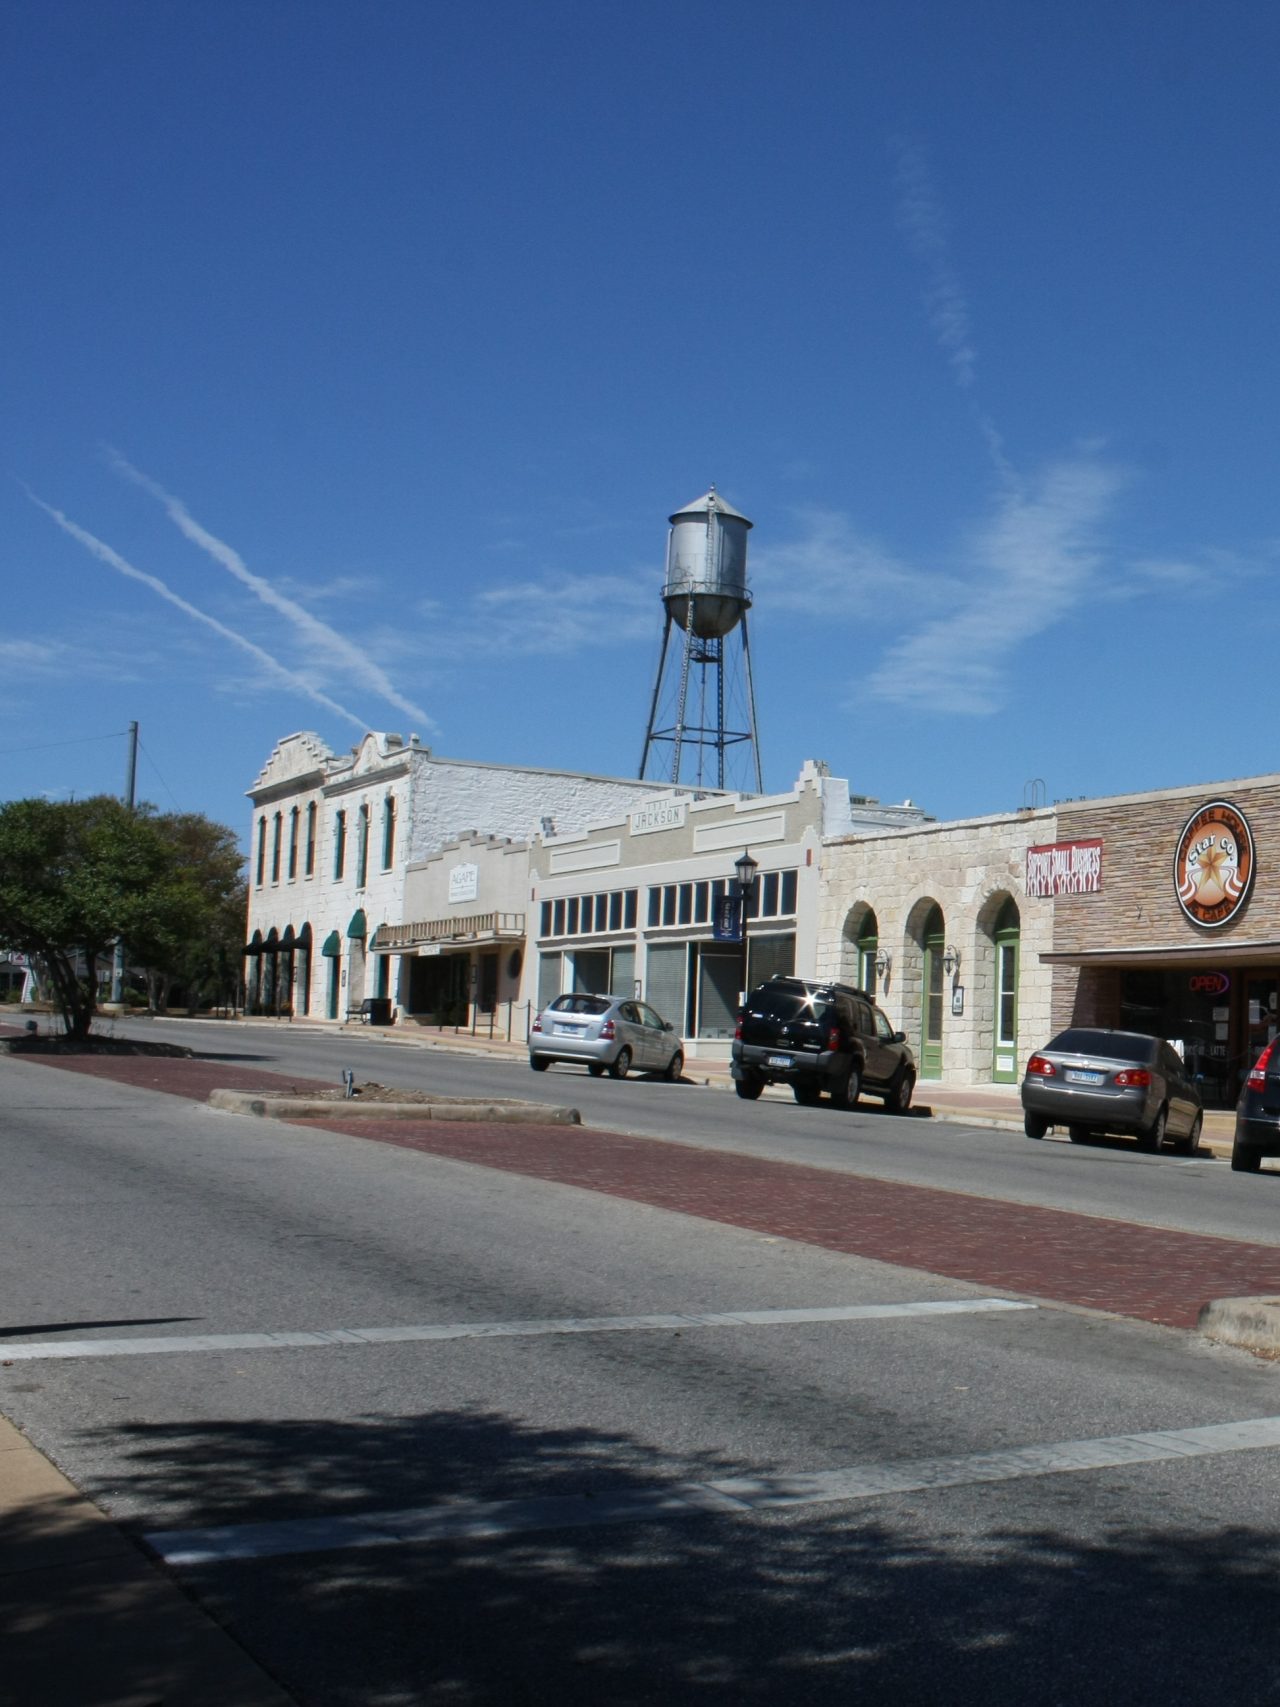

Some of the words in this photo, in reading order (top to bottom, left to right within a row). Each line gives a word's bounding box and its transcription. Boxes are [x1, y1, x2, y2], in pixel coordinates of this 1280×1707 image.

[635, 807, 680, 828] JACKSON
[1180, 810, 1215, 861] COFFEE
[1220, 810, 1248, 856] HOUSE
[1188, 833, 1217, 867] Star
[1189, 976, 1222, 992] OPEN
